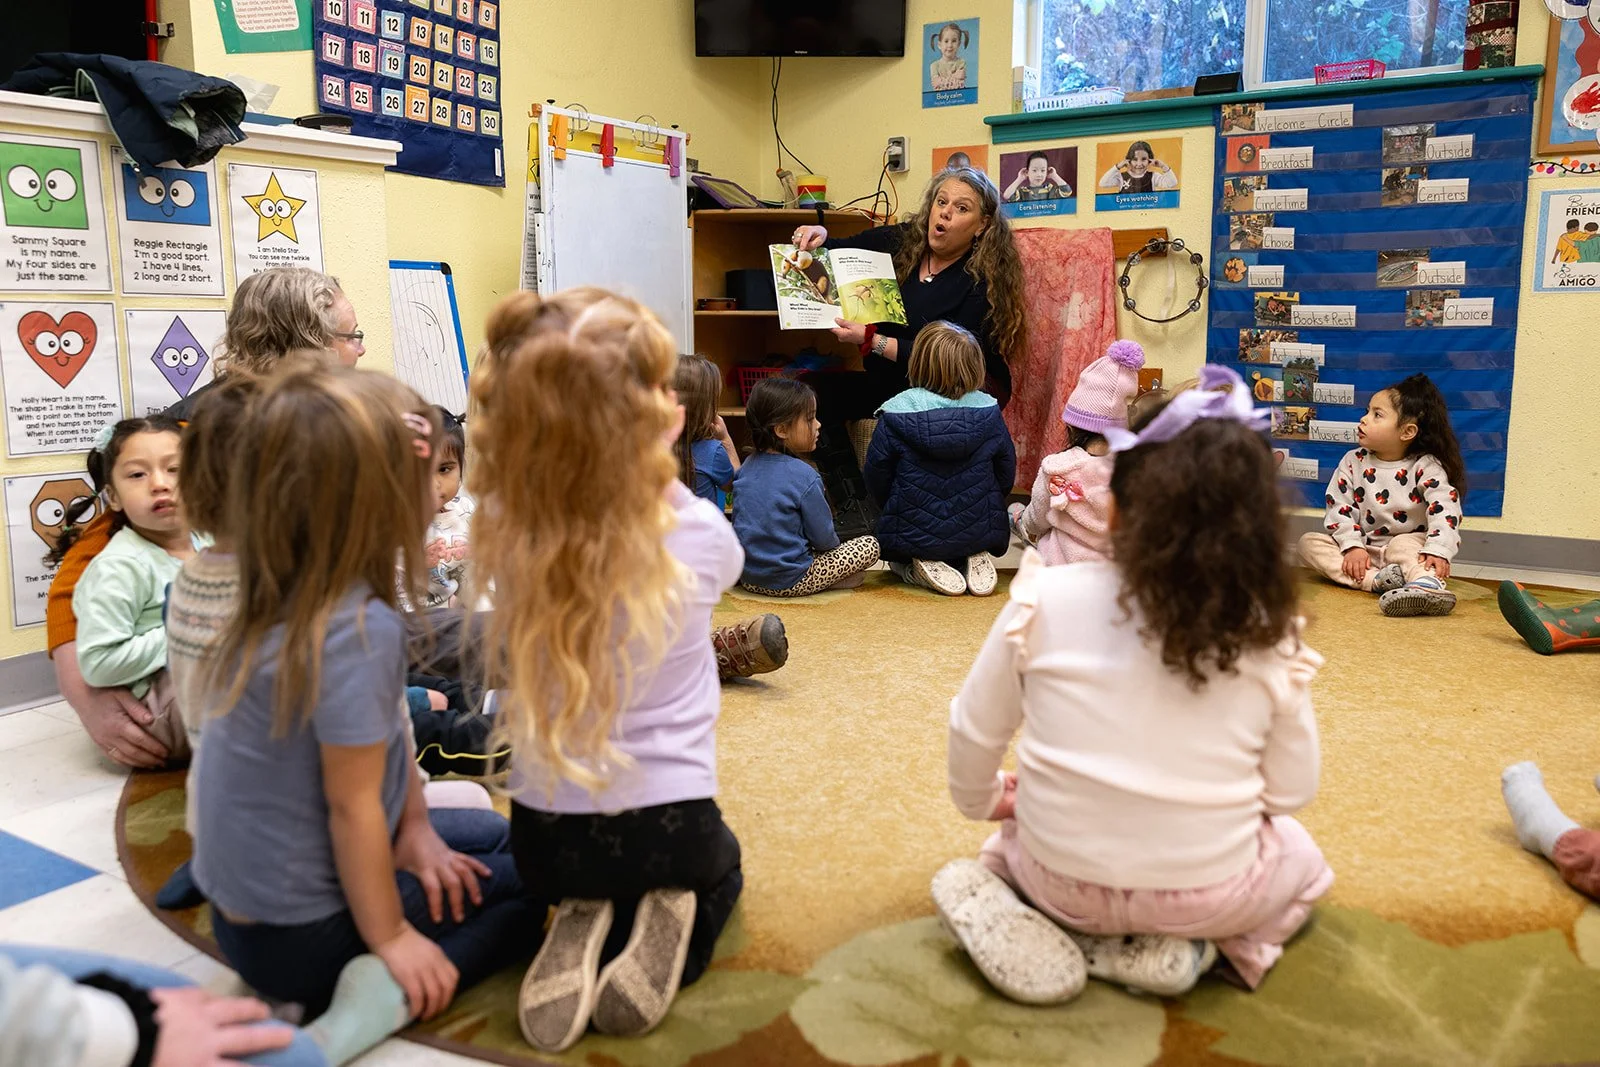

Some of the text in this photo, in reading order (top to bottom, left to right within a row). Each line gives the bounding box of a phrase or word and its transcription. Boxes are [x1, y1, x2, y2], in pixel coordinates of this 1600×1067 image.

[329, 3, 341, 16] 10
[462, 3, 468, 14] 8
[360, 10, 370, 25] 11
[484, 10, 490, 21] 9
[387, 19, 398, 32] 12
[416, 26, 426, 39] 13
[439, 33, 448, 46] 14
[461, 38, 471, 52] 15
[328, 42, 340, 55] 17
[484, 45, 494, 58] 16
[359, 50, 370, 63] 18
[387, 57, 399, 70] 19
[414, 63, 426, 76] 20
[438, 70, 449, 83] 21
[460, 76, 470, 89] 22
[327, 83, 340, 97] 24
[482, 81, 492, 93] 23
[355, 90, 368, 104] 25
[386, 96, 399, 109] 26
[413, 100, 425, 114] 27
[436, 106, 447, 119] 28
[460, 110, 472, 125] 29
[484, 116, 496, 129] 30
[1256, 112, 1349, 131] Welcome Circle
[1426, 140, 1470, 160] Outside
[1260, 153, 1310, 170] Breakfast
[1116, 194, 1158, 204] Eyes watching
[1418, 186, 1466, 202] Centers
[1568, 194, 1589, 207] Be
[1032, 203, 1056, 211] listening
[12, 235, 86, 249] Sammy Square
[134, 238, 208, 251] Reggie Rectangle
[1264, 235, 1293, 248] Choice
[20, 247, 80, 259] is my name.
[134, 250, 151, 259] I'm
[161, 251, 182, 261] good
[185, 252, 210, 263] sport.
[6, 260, 22, 270] My
[26, 260, 48, 270] four
[51, 260, 76, 270] sides
[142, 261, 148, 270] I
[150, 262, 172, 270] have
[174, 262, 180, 271] 4
[16, 271, 88, 282] just the same.
[134, 272, 140, 280] 2
[142, 272, 160, 283] long
[162, 273, 180, 281] and
[188, 274, 213, 283] short.
[1250, 272, 1282, 286] Lunch
[1418, 268, 1462, 284] Outside
[1559, 278, 1596, 286] AMIGO
[1293, 310, 1323, 326] Books
[1331, 311, 1354, 326] Rest
[1444, 304, 1488, 321] Choice
[1314, 388, 1352, 404] Outside
[25, 405, 47, 413] shape
[43, 413, 61, 421] point
[57, 420, 81, 429] humps
[1311, 426, 1340, 441] Music
[43, 438, 58, 446] just
[1286, 463, 1316, 478] Home
